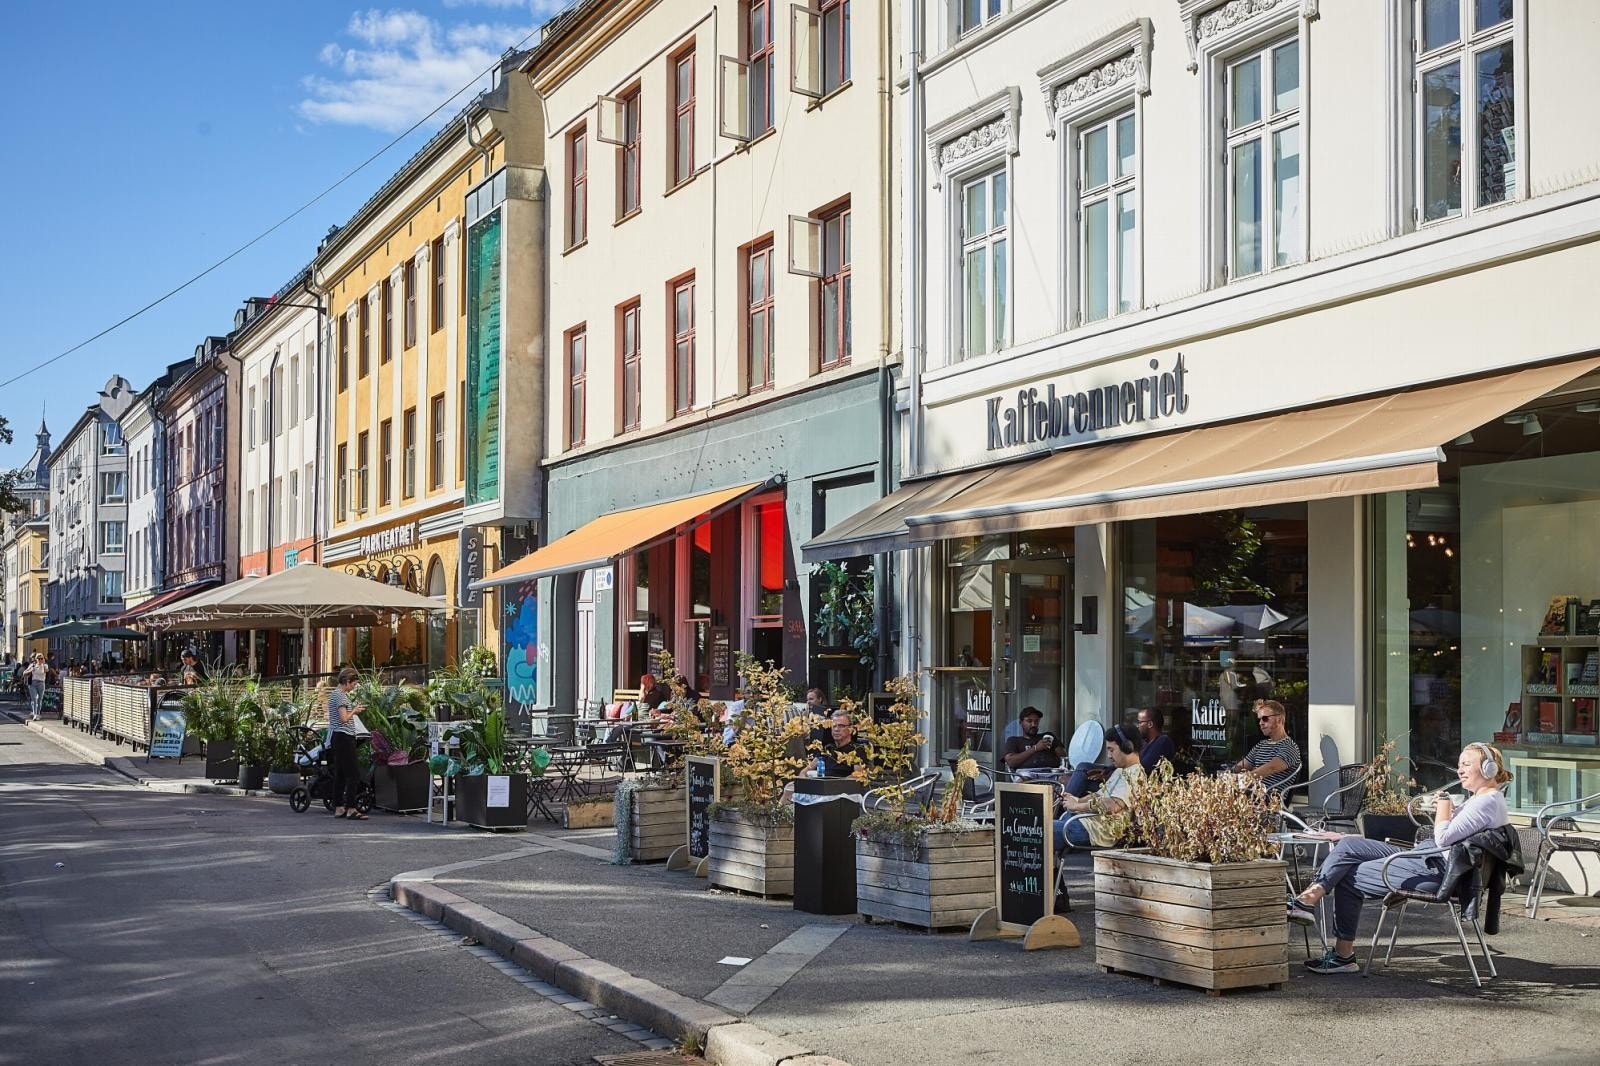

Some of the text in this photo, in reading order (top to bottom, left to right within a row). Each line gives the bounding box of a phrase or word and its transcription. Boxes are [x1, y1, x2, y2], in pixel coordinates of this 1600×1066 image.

[986, 352, 1189, 450] Kaffebrenneriet
[360, 521, 416, 556] PARKTEATRET
[967, 689, 991, 711] Kaffe
[1191, 698, 1226, 726] Kaffe
[1191, 725, 1226, 741] brenneriet
